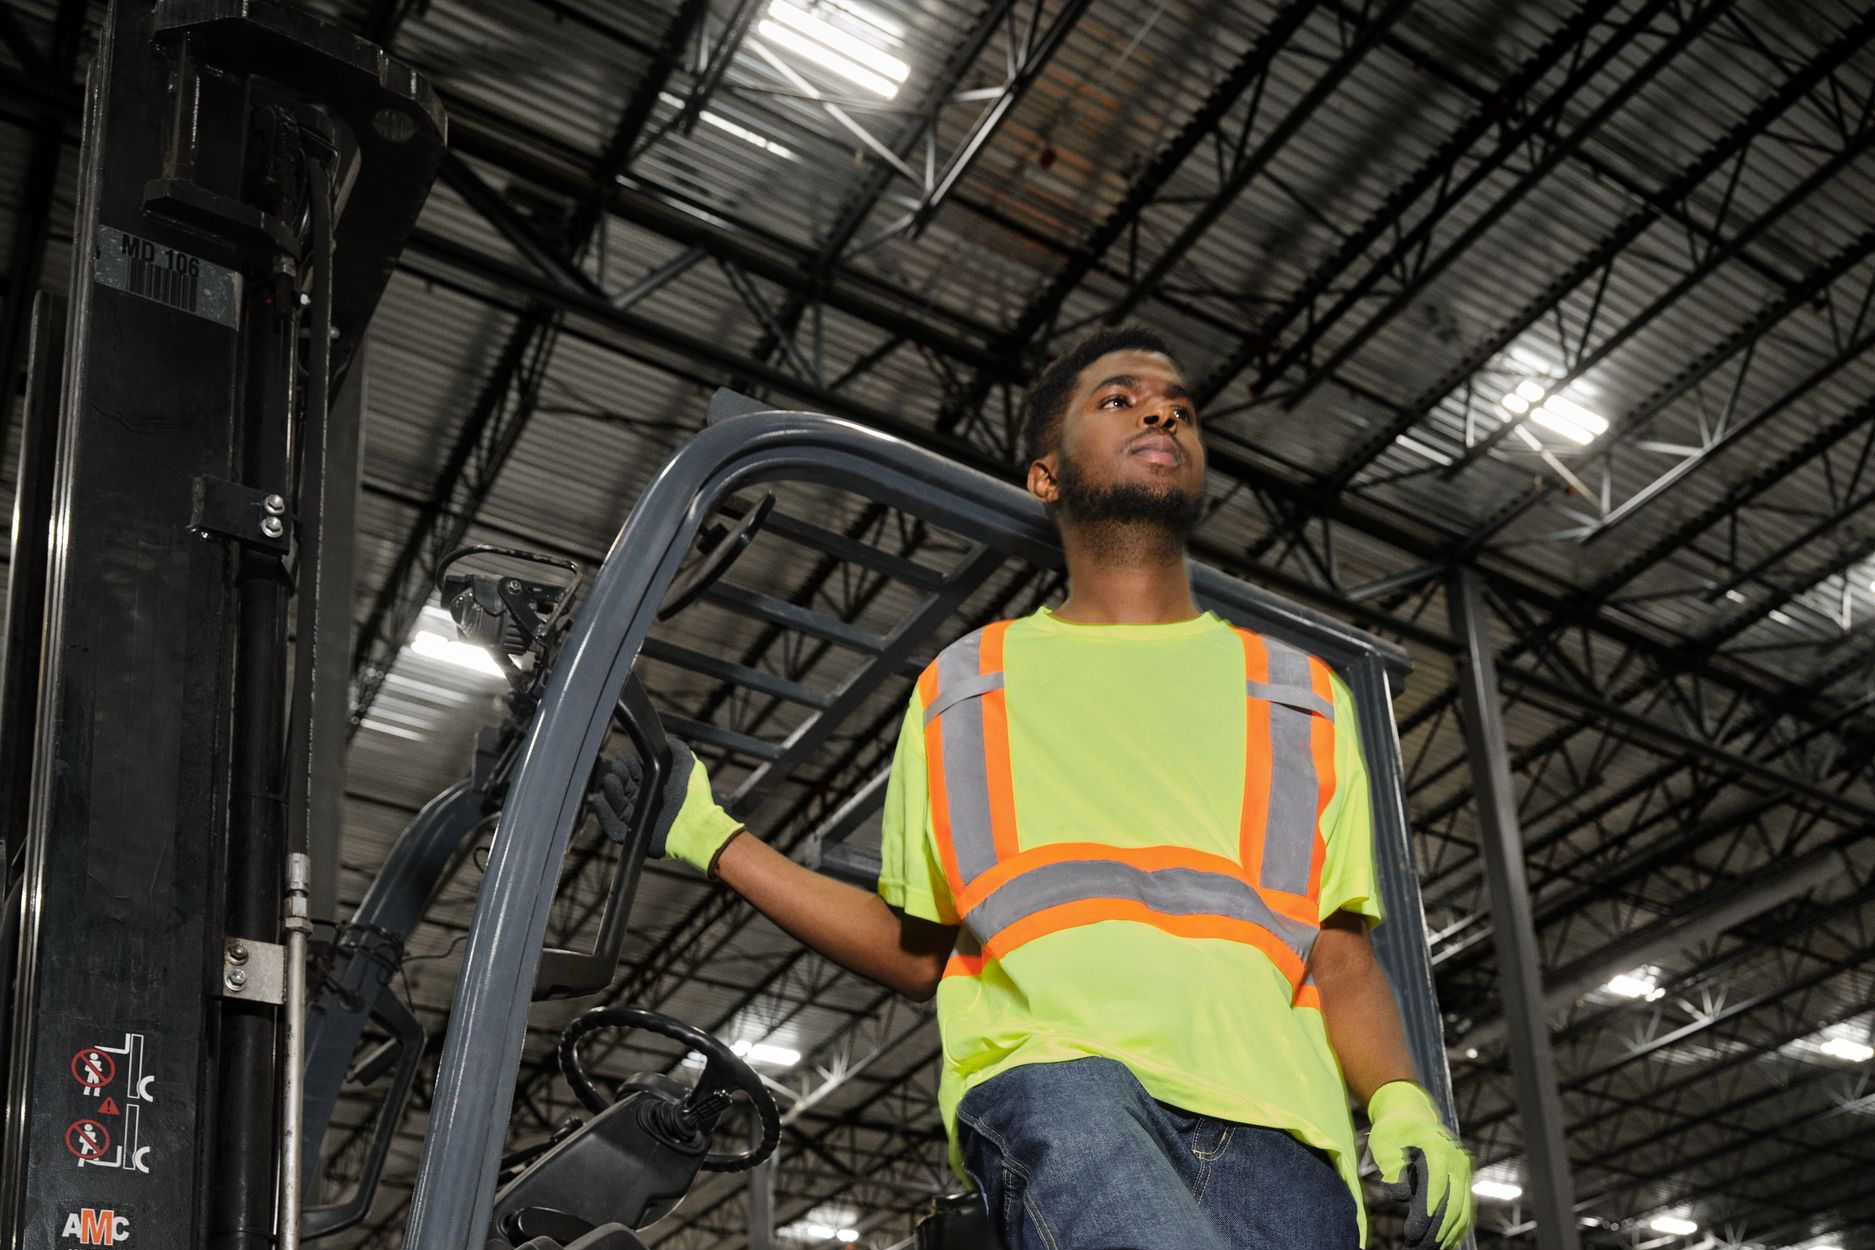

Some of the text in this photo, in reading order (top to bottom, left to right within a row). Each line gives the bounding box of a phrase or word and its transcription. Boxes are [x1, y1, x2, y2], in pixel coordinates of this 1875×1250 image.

[121, 234, 155, 262] MD
[165, 249, 200, 277] 106
[61, 1207, 130, 1246] AMC
